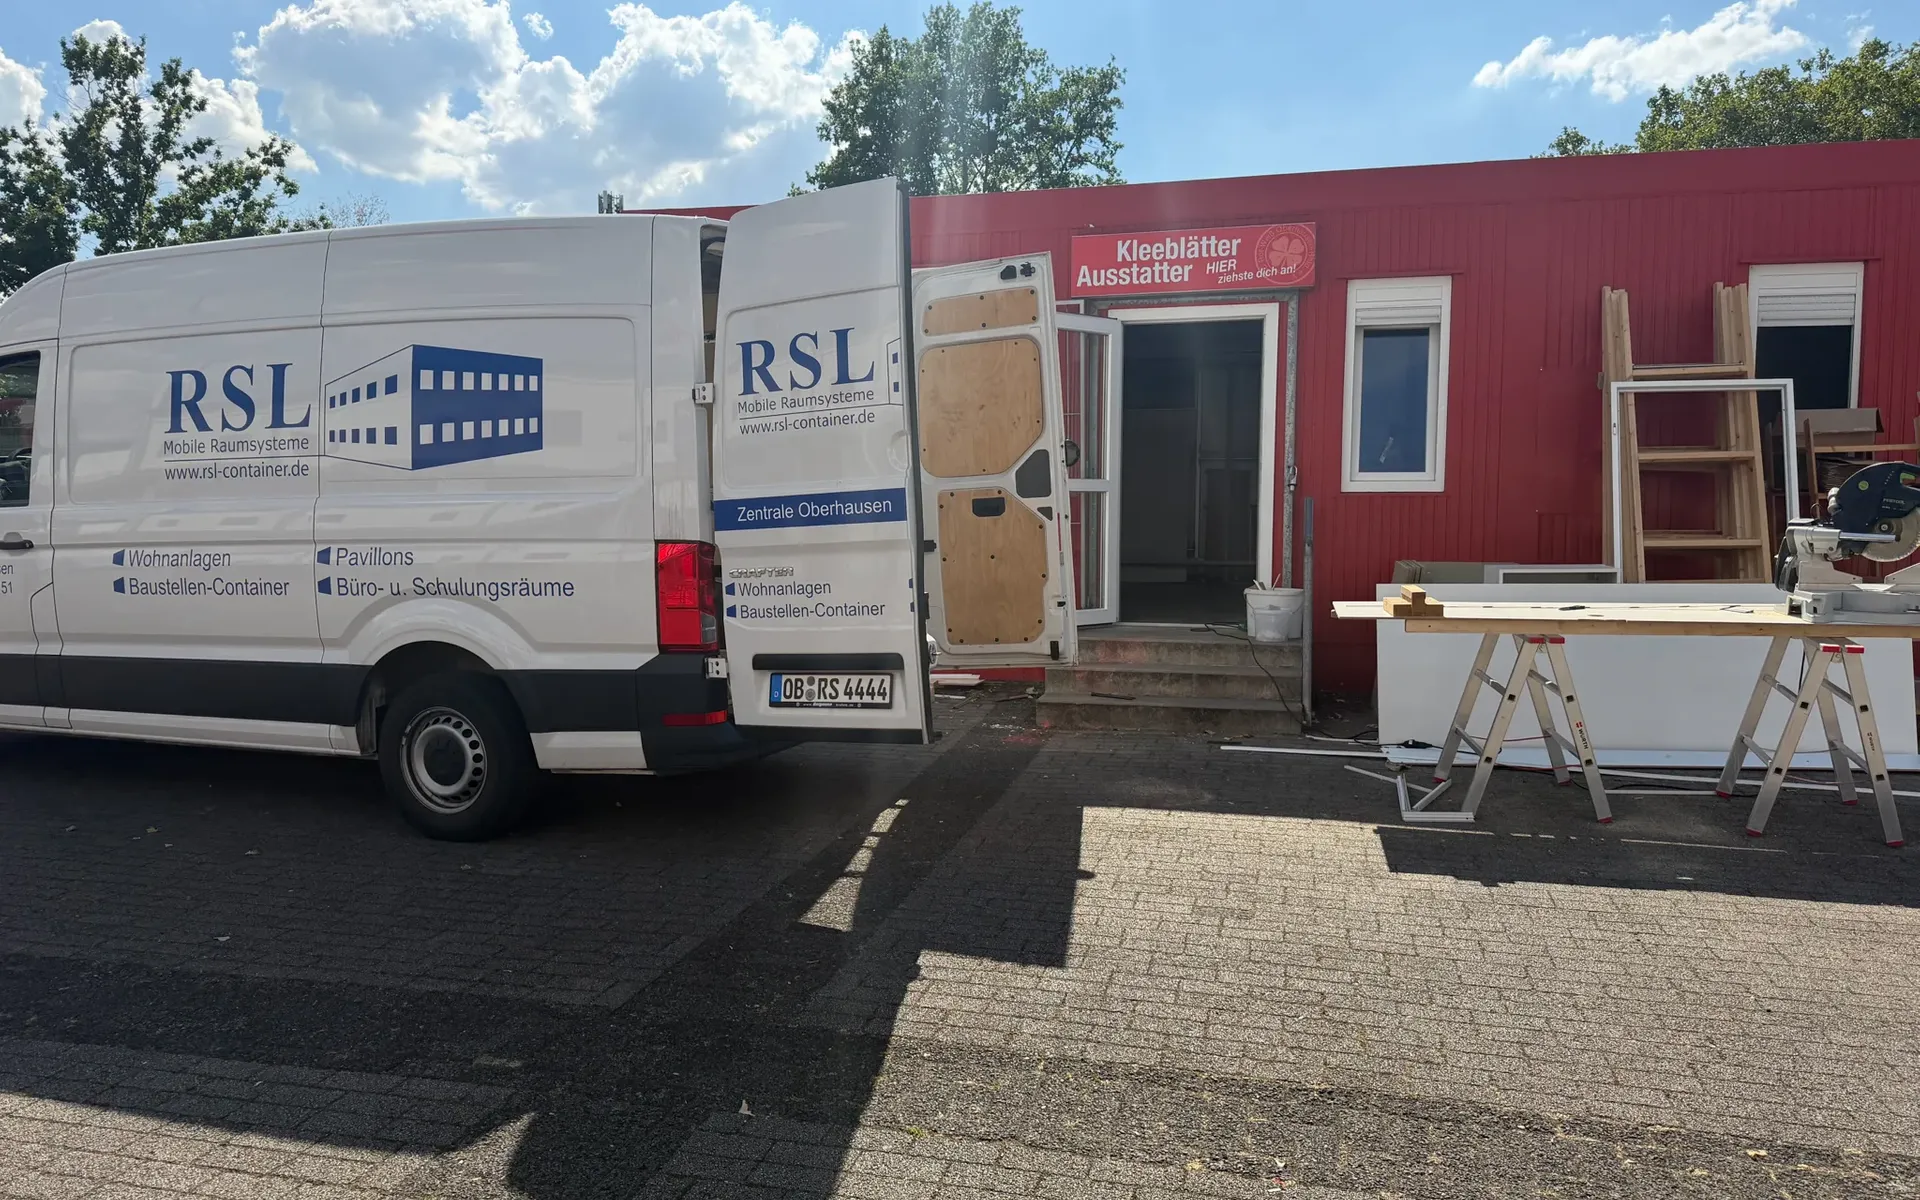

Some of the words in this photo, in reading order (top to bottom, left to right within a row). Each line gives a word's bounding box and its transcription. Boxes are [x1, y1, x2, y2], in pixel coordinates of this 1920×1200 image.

[1117, 236, 1242, 262] Kleeblätter
[1076, 262, 1194, 288] Ausstatter
[1206, 259, 1237, 274] HIER
[1218, 271, 1254, 284] ziehste
[1256, 266, 1278, 278] dich
[1280, 264, 1296, 275] an!
[736, 327, 874, 396] RSL
[164, 363, 311, 434] RSL
[738, 398, 777, 414] Mobile
[781, 389, 874, 409] Raumsysteme
[740, 409, 875, 435] www.rsl-container.de
[163, 440, 205, 454] Mobile
[210, 436, 309, 454] Raumsysteme
[164, 459, 309, 480] www.rsl-container.de
[737, 504, 794, 522] Zentrale
[798, 500, 892, 517] Oberhausen
[128, 549, 231, 571] Wohnanlagen
[336, 547, 414, 566] Pavillons
[0, 564, 14, 575] en
[729, 566, 794, 578] CRAFTER
[129, 577, 289, 596] Baustellen-Container
[336, 577, 384, 597] Büro-
[390, 582, 407, 597] u.
[412, 577, 575, 601] Schulungsräume
[739, 581, 831, 598] Wohnanlagen
[740, 600, 885, 619] Baustellen-Container
[783, 678, 804, 700] OB
[817, 678, 840, 700] RS
[843, 678, 888, 700] 4444
